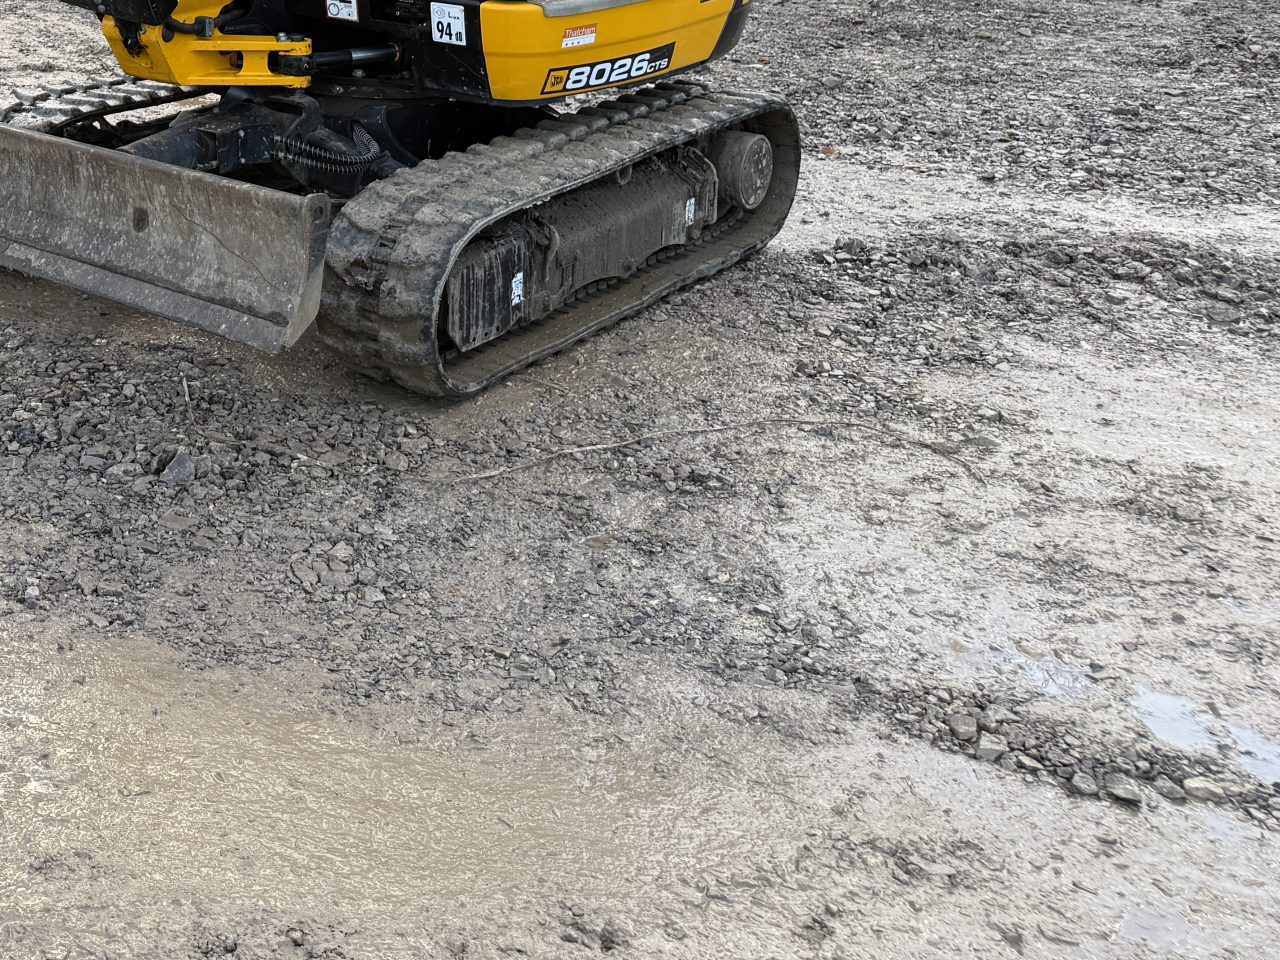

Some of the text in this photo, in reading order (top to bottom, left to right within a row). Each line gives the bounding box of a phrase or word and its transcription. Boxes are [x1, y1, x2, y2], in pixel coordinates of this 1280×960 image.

[436, 20, 453, 41] 94
[565, 27, 596, 38] Thatcham
[565, 53, 669, 90] 8026 CTS
